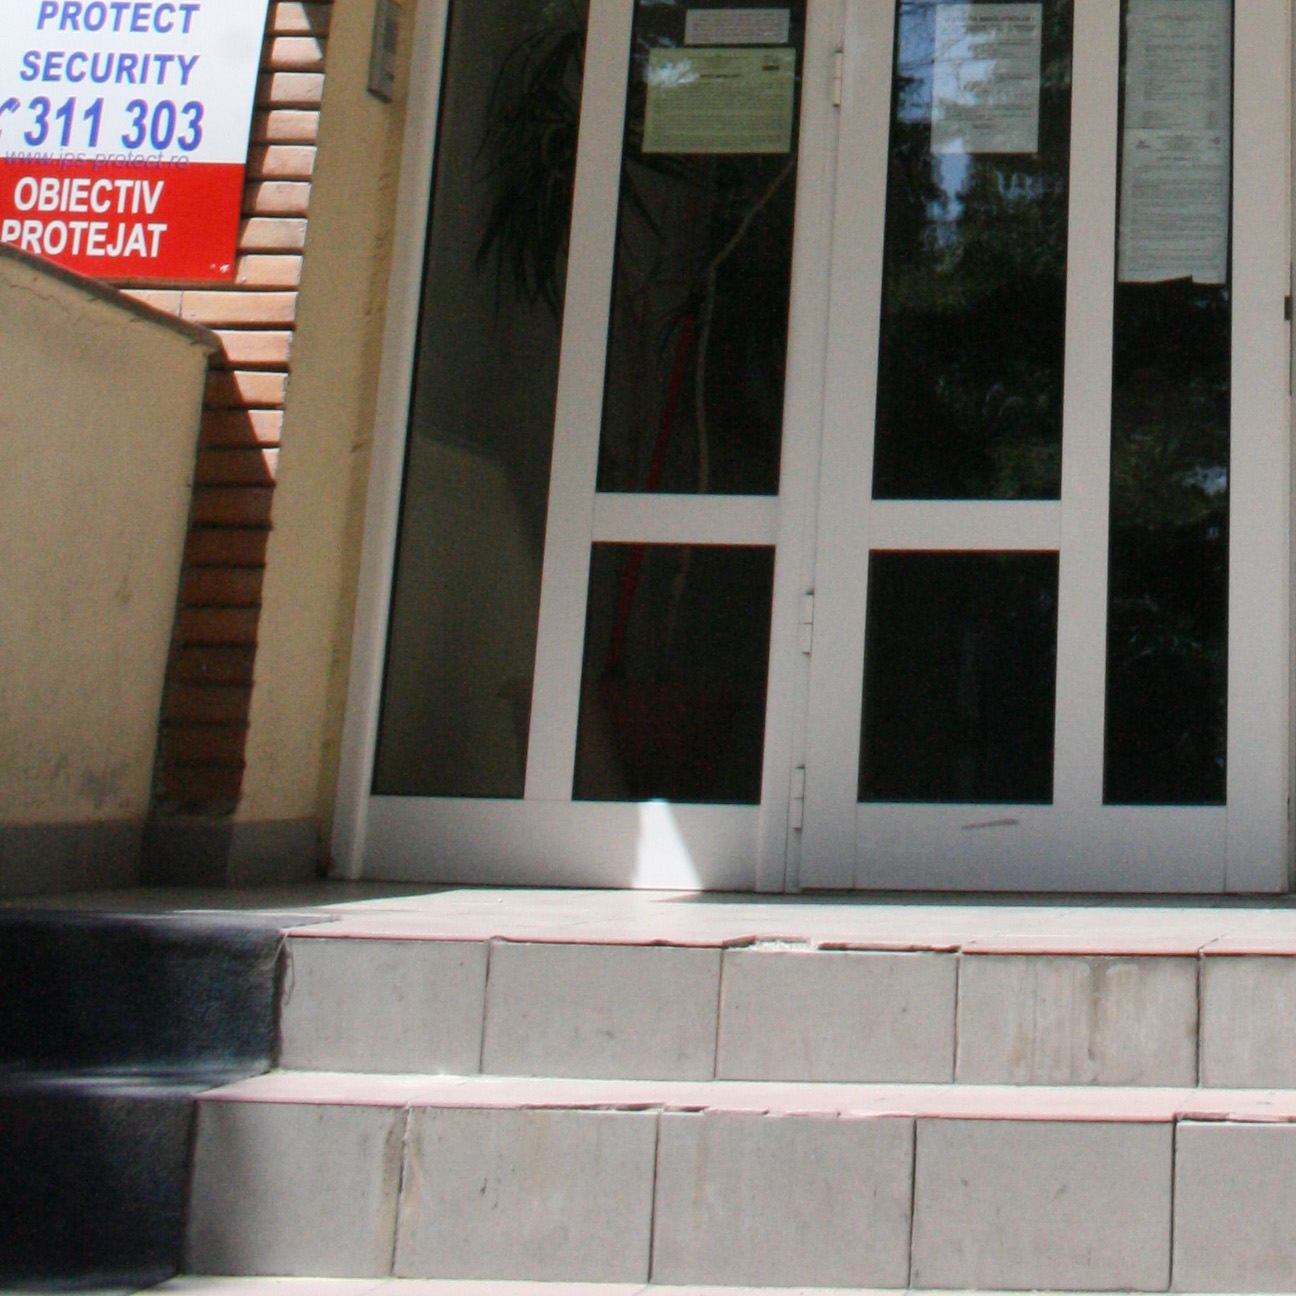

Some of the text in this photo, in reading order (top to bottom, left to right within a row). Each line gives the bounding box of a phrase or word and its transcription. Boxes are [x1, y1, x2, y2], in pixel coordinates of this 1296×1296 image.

[37, 0, 200, 35] PROTECT
[19, 50, 200, 86] SECURITY
[24, 96, 205, 151] 311 303
[14, 176, 165, 214] OBIECTIV
[1, 219, 168, 258] PROTEJAT
